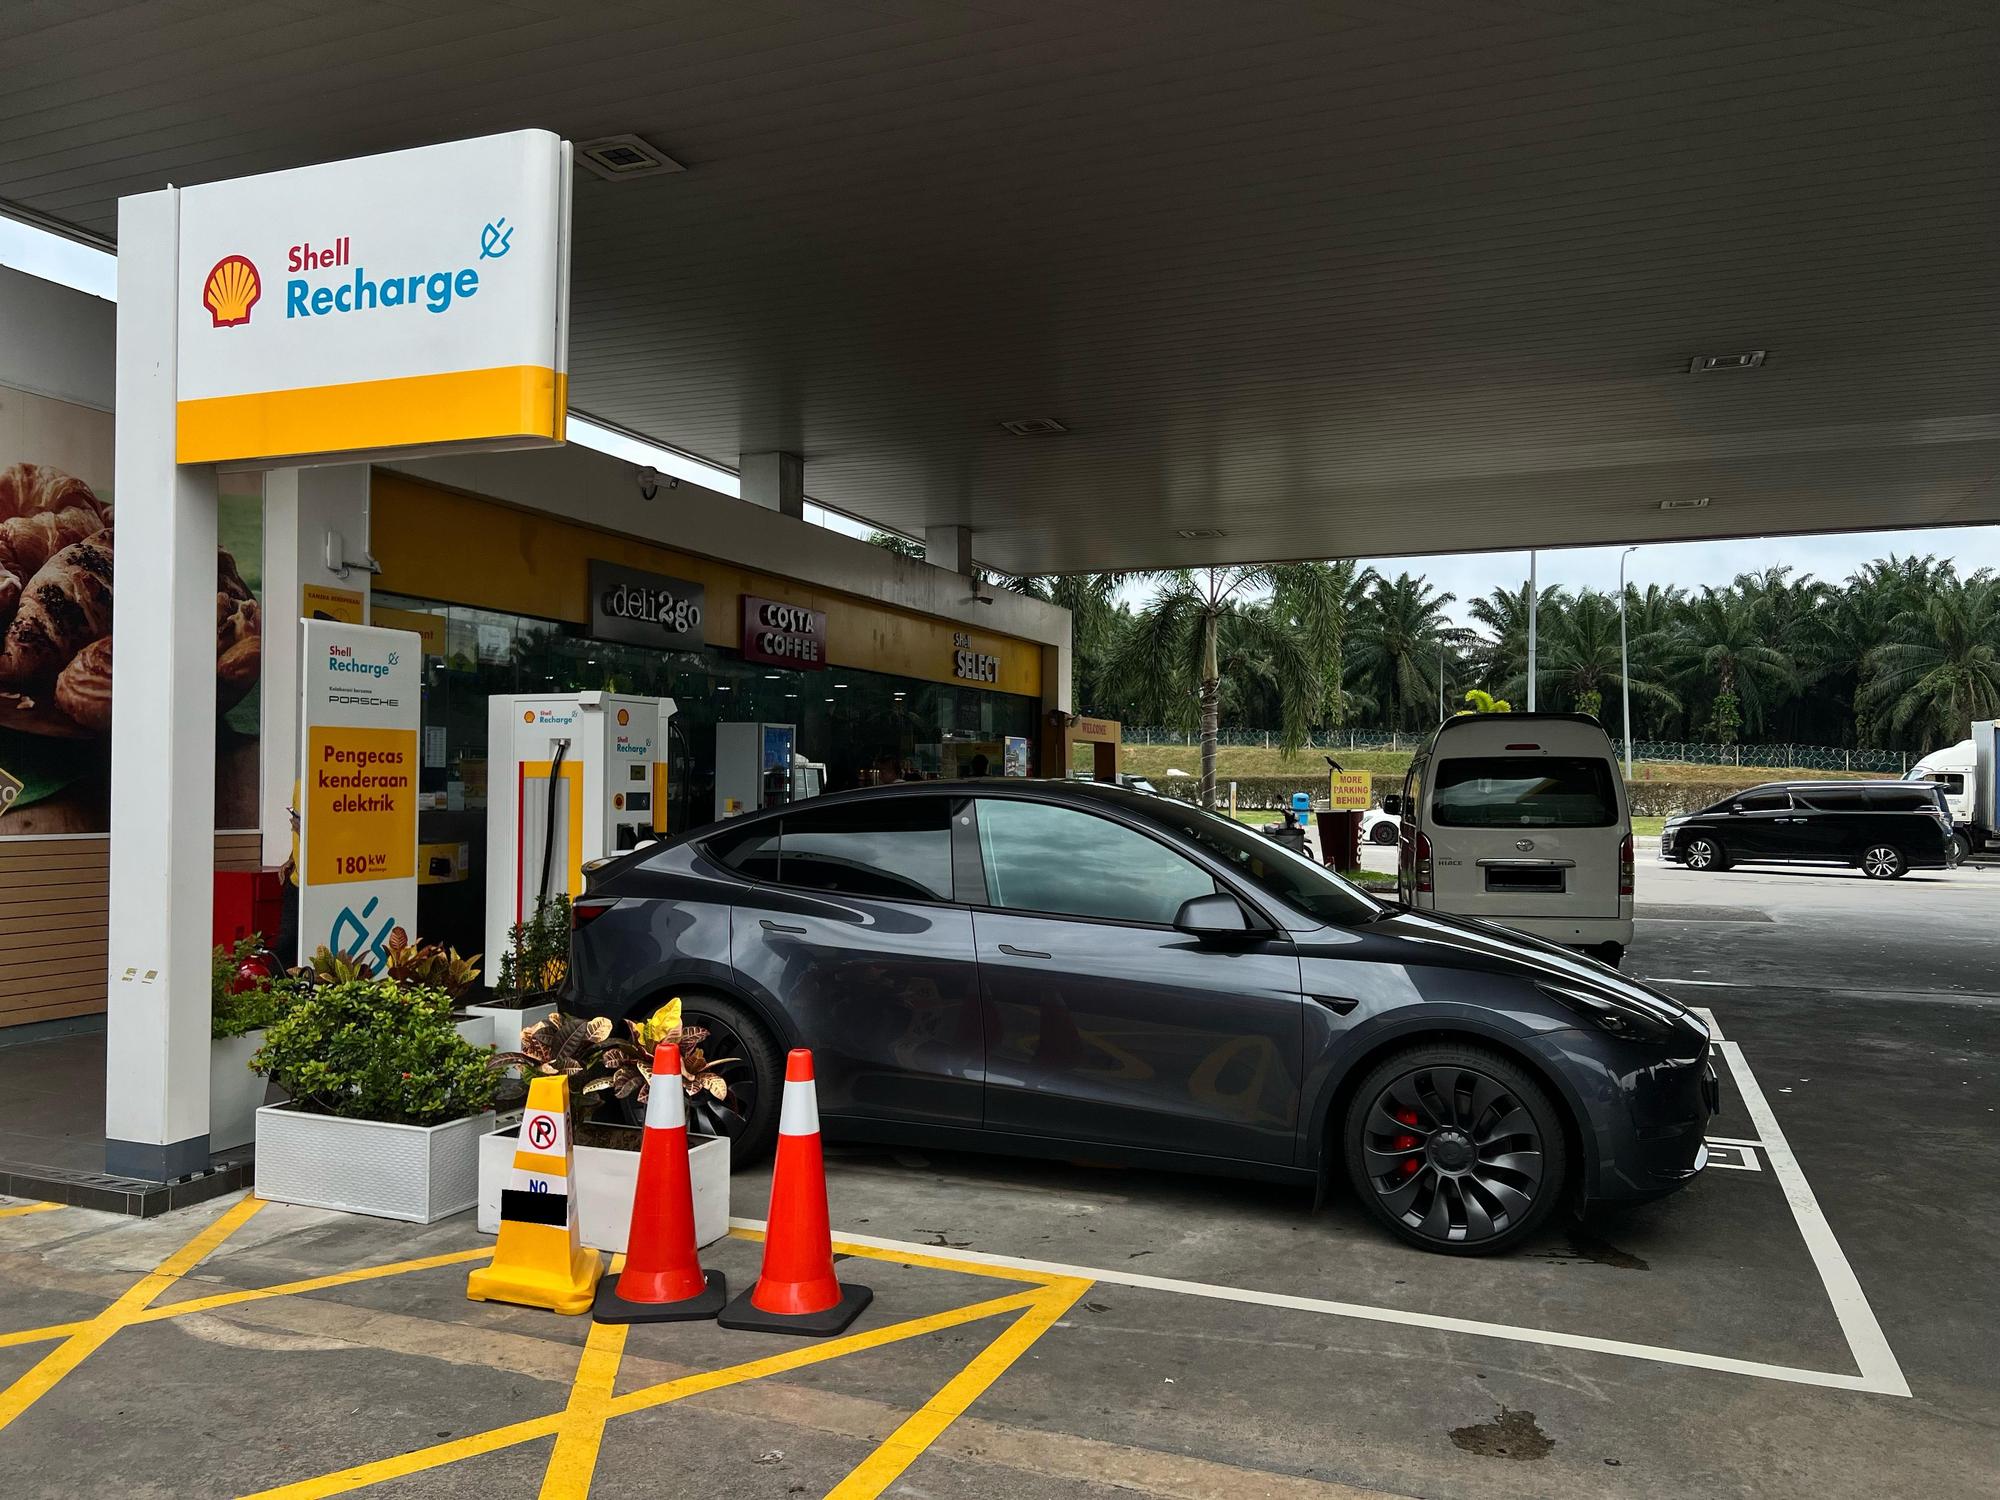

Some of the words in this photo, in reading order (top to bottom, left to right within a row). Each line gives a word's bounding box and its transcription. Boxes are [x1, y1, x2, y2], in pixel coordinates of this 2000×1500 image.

[288, 237, 350, 273] Shell
[286, 267, 479, 319] Recharge
[613, 583, 700, 633] deli2go
[766, 604, 815, 633] COSTA
[763, 632, 819, 662] COFFEE
[954, 632, 972, 649] Shell
[329, 645, 352, 657] Shell
[329, 657, 389, 678] Recharge
[957, 651, 1000, 683] SELECT
[329, 695, 399, 707] PORSCHE
[539, 716, 573, 725] Recharge
[1081, 722, 1107, 736] WELCOME
[324, 745, 404, 768] Pengecas
[616, 743, 647, 755] Recharge
[319, 769, 408, 788] kenderaan
[1340, 775, 1363, 784] MORE
[1333, 785, 1369, 795] PARKING
[333, 793, 395, 813] elektrik
[1336, 796, 1366, 805] BEHIND
[336, 855, 367, 875] 180
[368, 854, 386, 865] kW
[529, 1178, 549, 1194] NO
